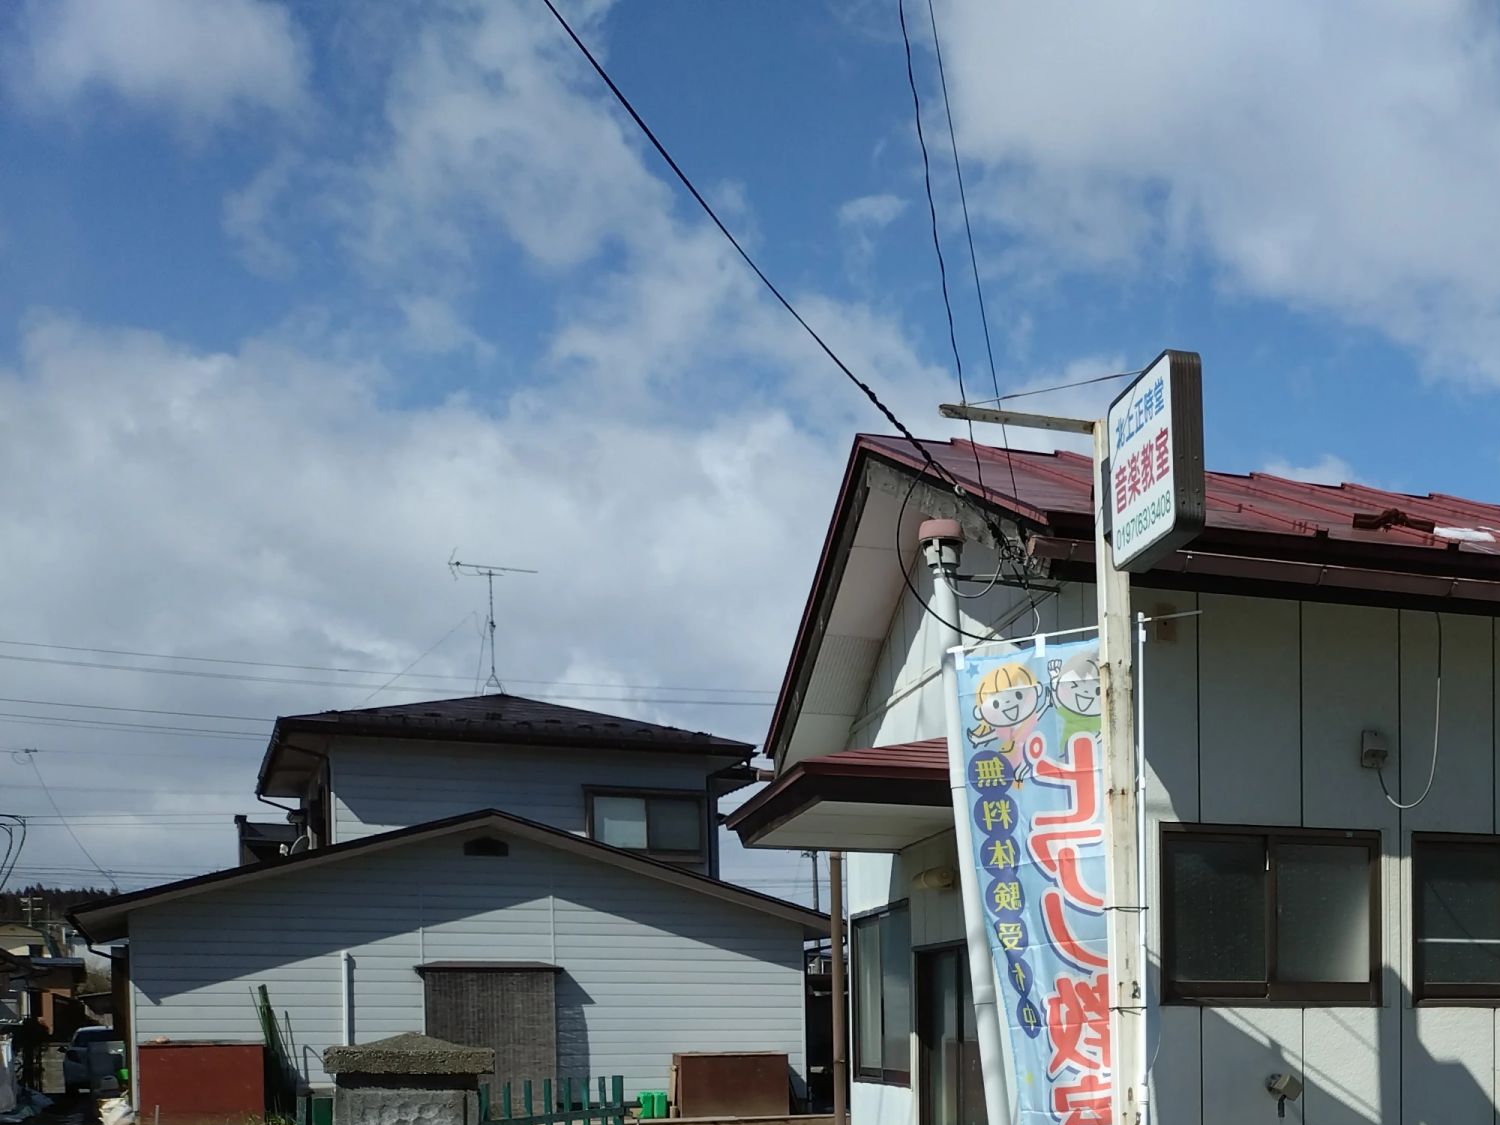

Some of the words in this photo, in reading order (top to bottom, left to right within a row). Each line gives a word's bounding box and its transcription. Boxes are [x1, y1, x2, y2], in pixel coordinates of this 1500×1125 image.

[1117, 377, 1165, 449] 北上正時堂
[1114, 427, 1170, 514] 音楽教室
[1116, 490, 1171, 551] 0197(63)3408
